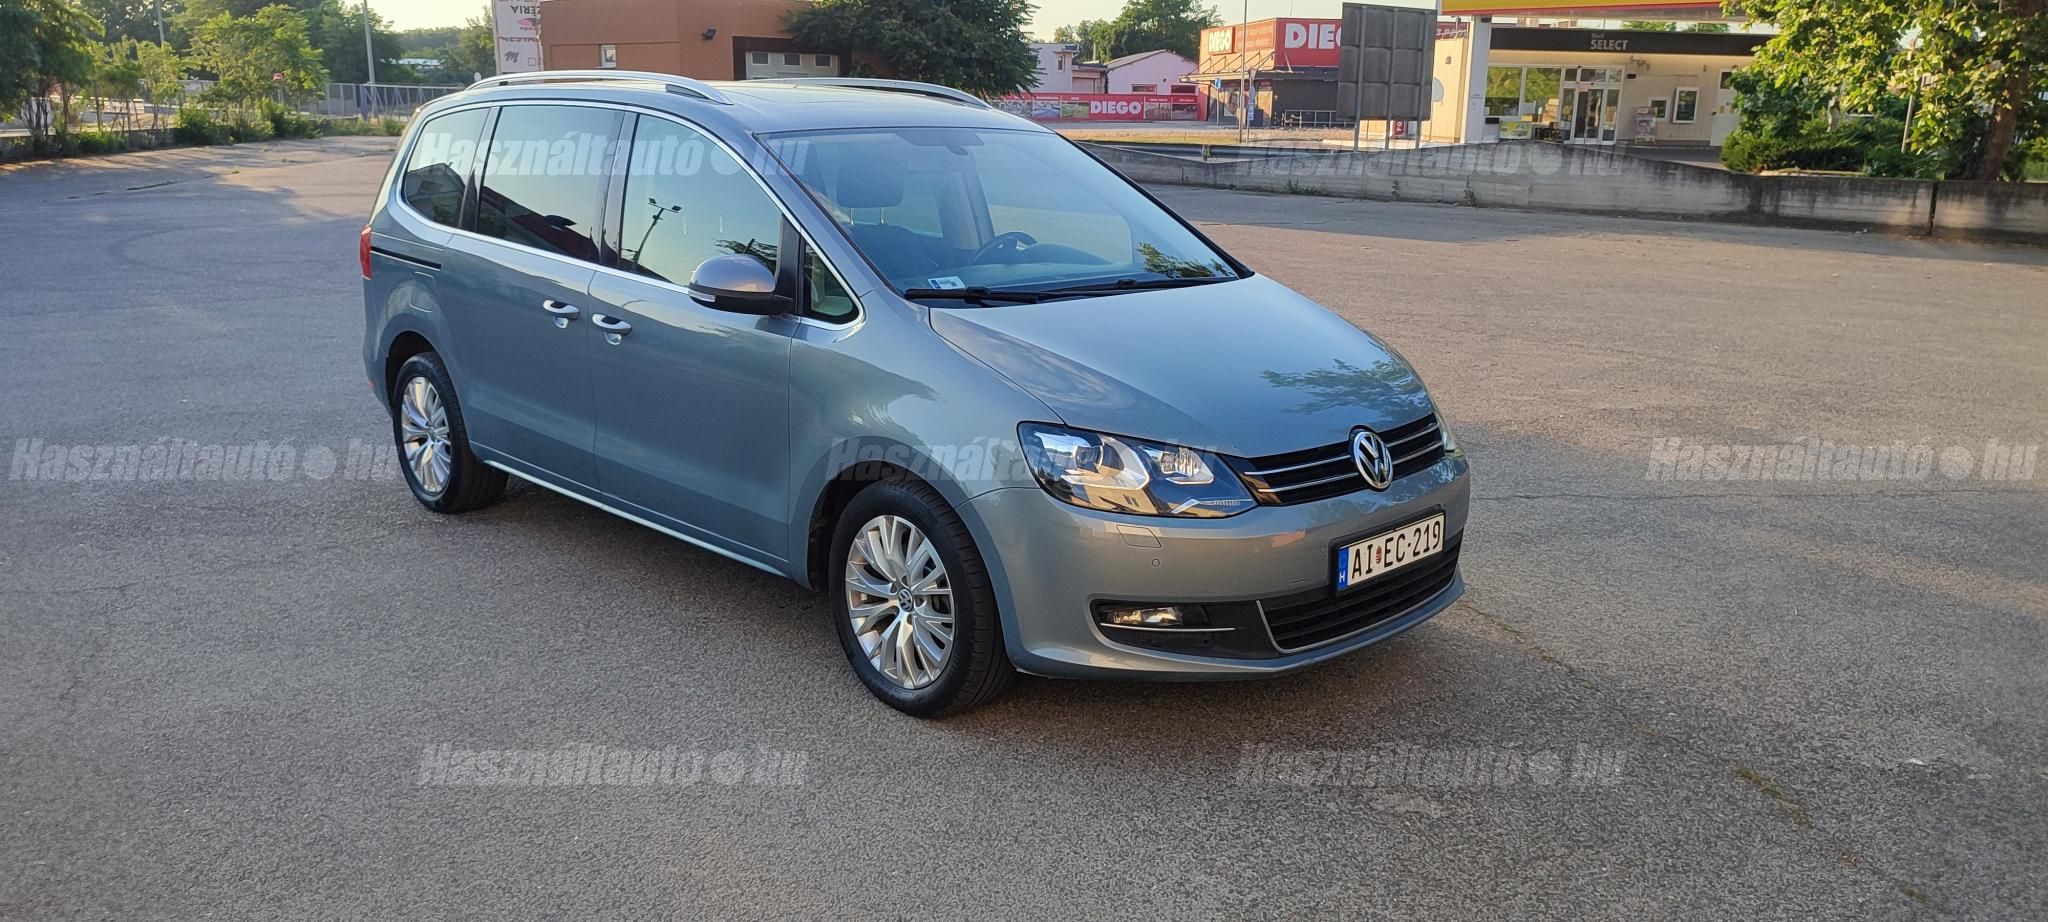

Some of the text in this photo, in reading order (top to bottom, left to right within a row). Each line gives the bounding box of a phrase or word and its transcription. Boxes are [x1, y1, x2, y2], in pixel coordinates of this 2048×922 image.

[1208, 29, 1232, 53] DIEGO
[1284, 23, 1341, 49] DIE
[1590, 39, 1628, 50] SELECT
[1090, 100, 1142, 114] DIEGO
